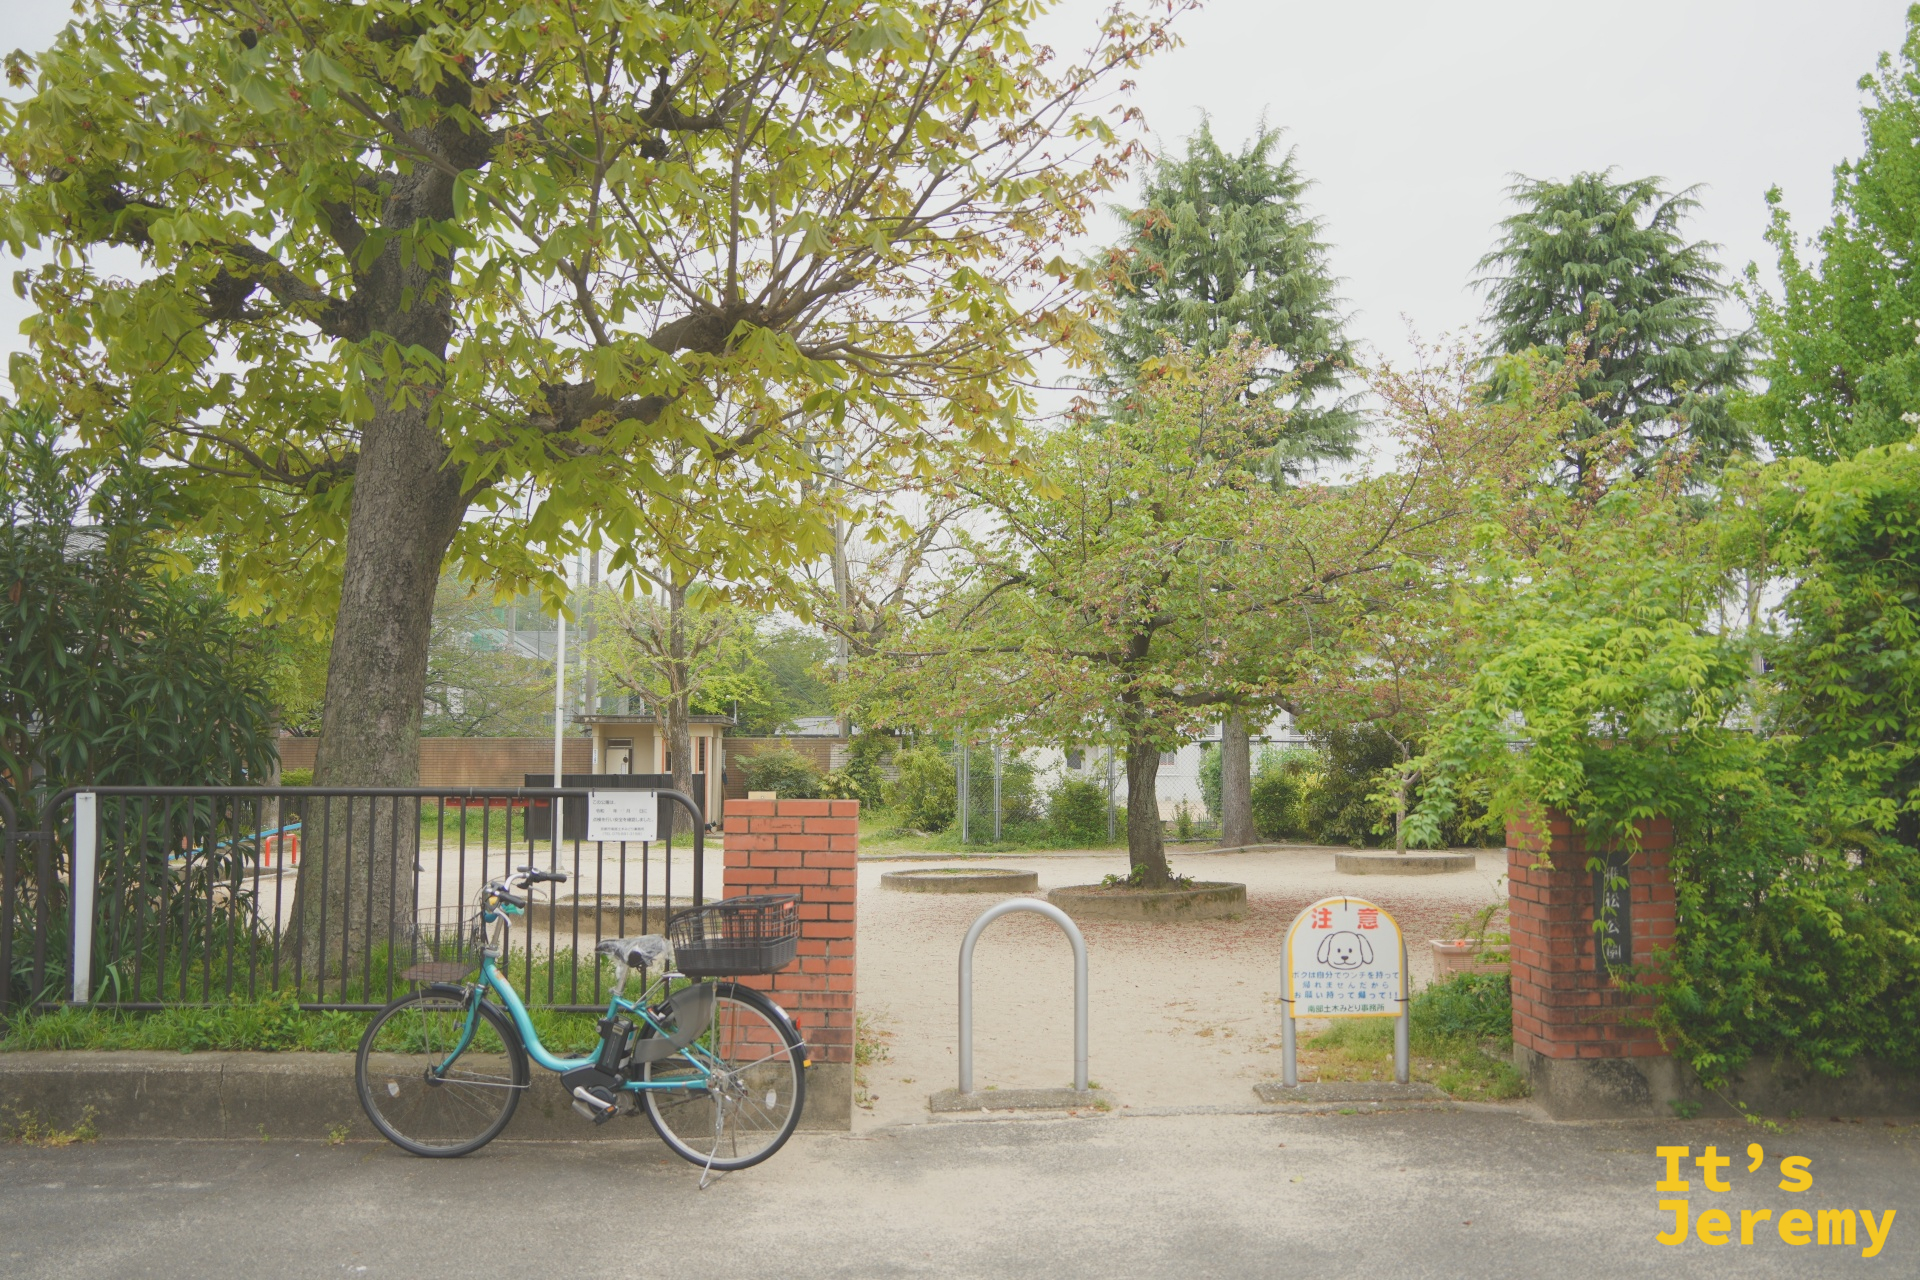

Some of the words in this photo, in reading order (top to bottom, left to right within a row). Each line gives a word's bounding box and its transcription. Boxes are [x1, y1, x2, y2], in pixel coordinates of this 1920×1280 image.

[1311, 907, 1379, 930] 注意
[1307, 1004, 1385, 1013] 南部土木みどり事務所
